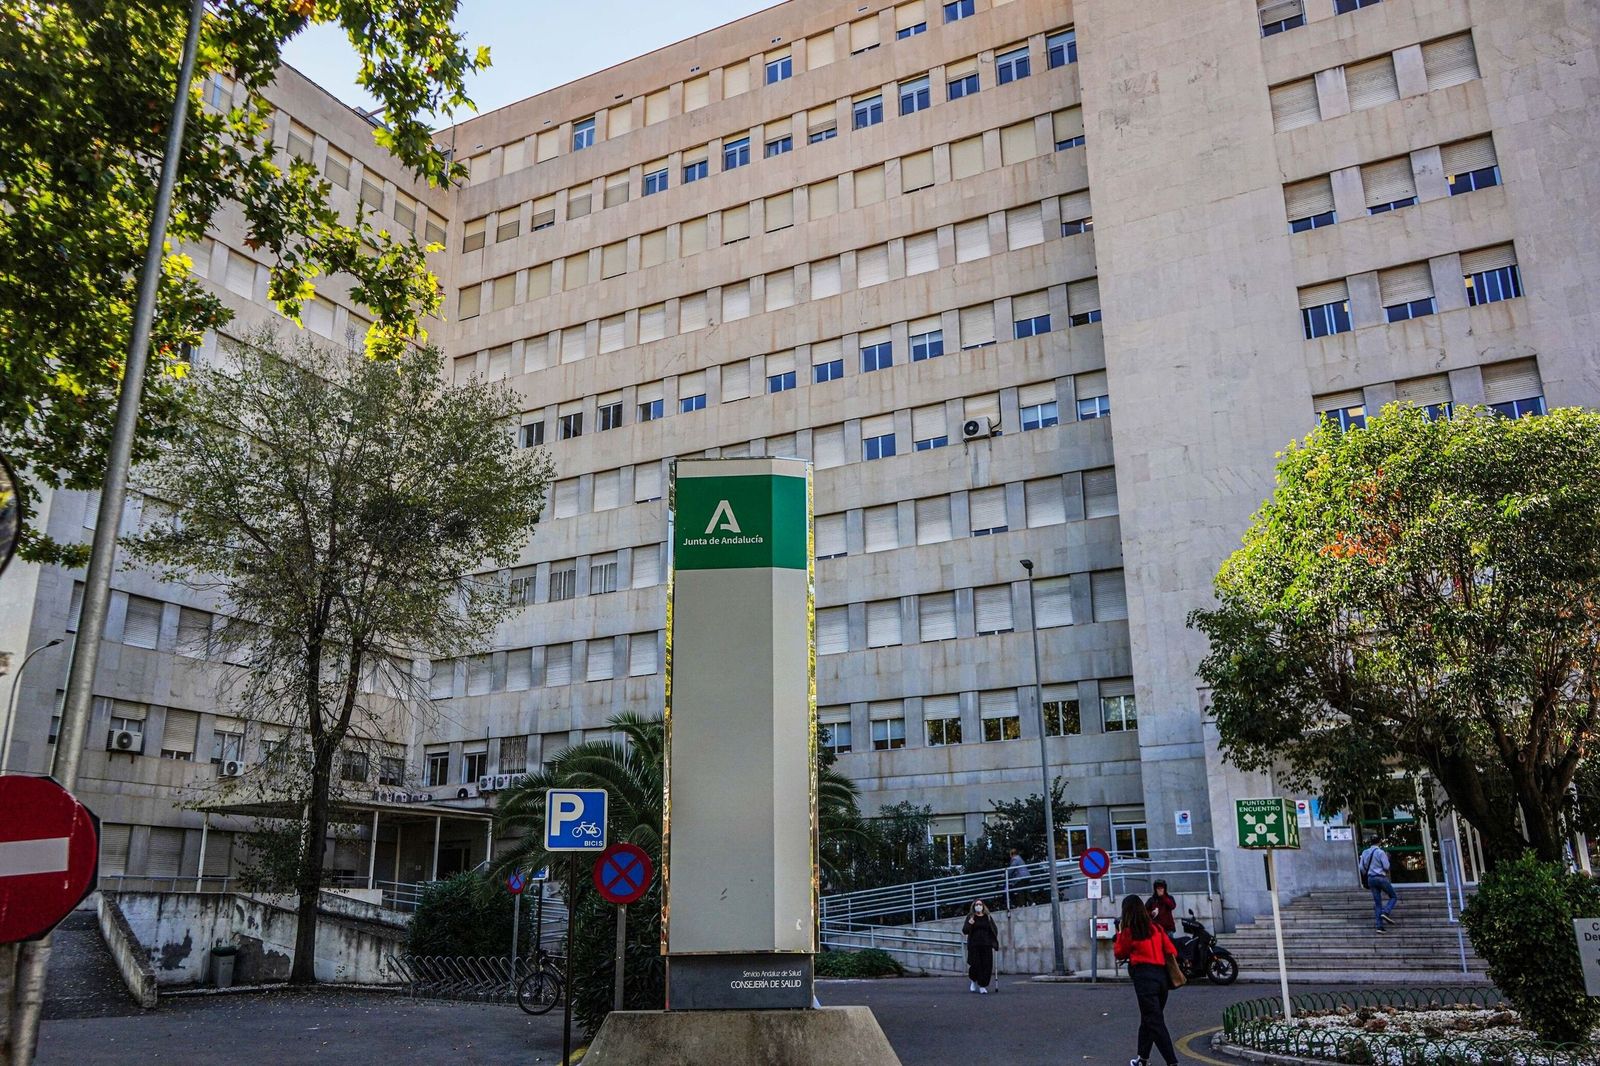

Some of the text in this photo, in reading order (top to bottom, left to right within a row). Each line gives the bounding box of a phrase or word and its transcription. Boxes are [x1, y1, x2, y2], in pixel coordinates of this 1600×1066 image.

[683, 534, 763, 546] Junta de Andalucía
[551, 793, 584, 836] P
[730, 979, 802, 988] CONSEJERÍA DE SALUD
